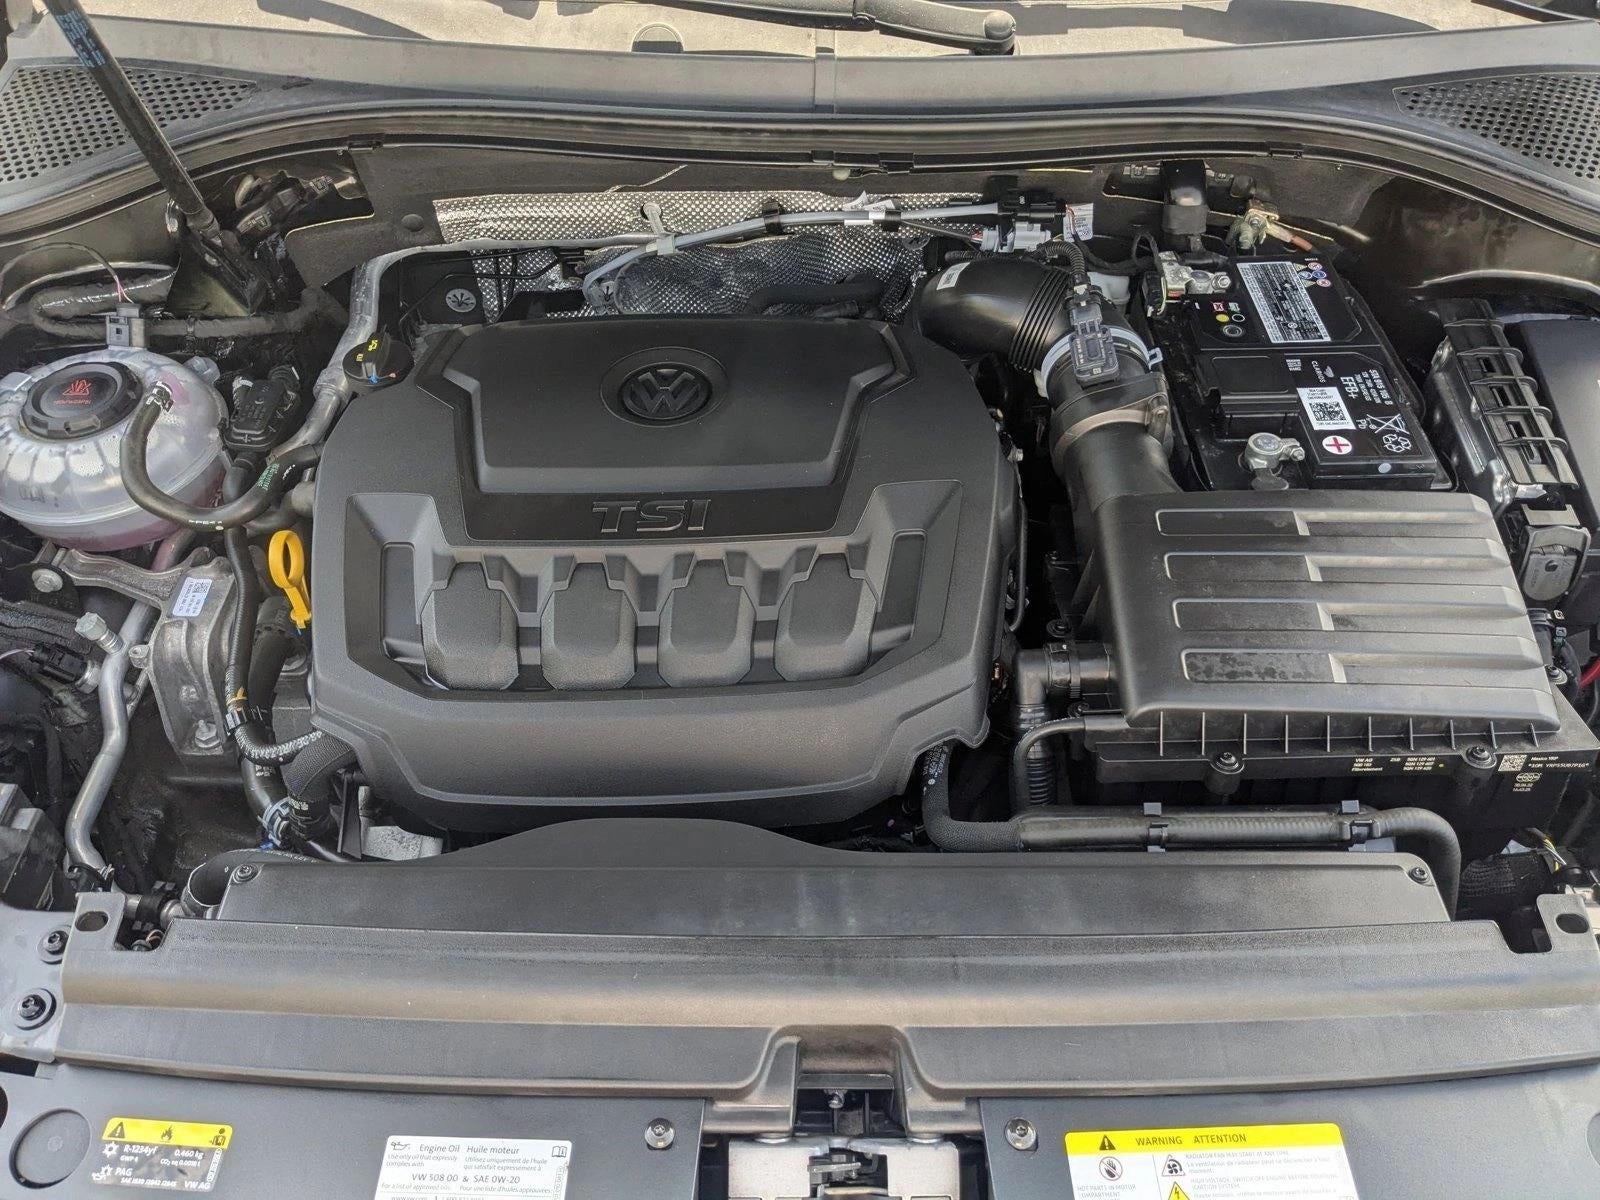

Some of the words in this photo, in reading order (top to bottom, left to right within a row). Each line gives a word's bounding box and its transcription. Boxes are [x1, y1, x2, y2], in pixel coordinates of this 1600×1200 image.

[1312, 360, 1326, 383] CLARIOS
[1340, 376, 1360, 399] EFB+
[1356, 419, 1367, 429] Pb
[592, 499, 712, 533] TSI
[1135, 1136, 1183, 1146] WARNING
[1193, 1134, 1247, 1144] ATTENTION
[123, 1144, 158, 1157] R-1234yf
[174, 1149, 195, 1157] 0.460
[195, 1151, 204, 1160] kg
[419, 1144, 447, 1154] Engine
[448, 1144, 460, 1152] Oil
[467, 1145, 488, 1154] Huile
[115, 1168, 132, 1177] PAG
[491, 1175, 520, 1184] 0W-20
